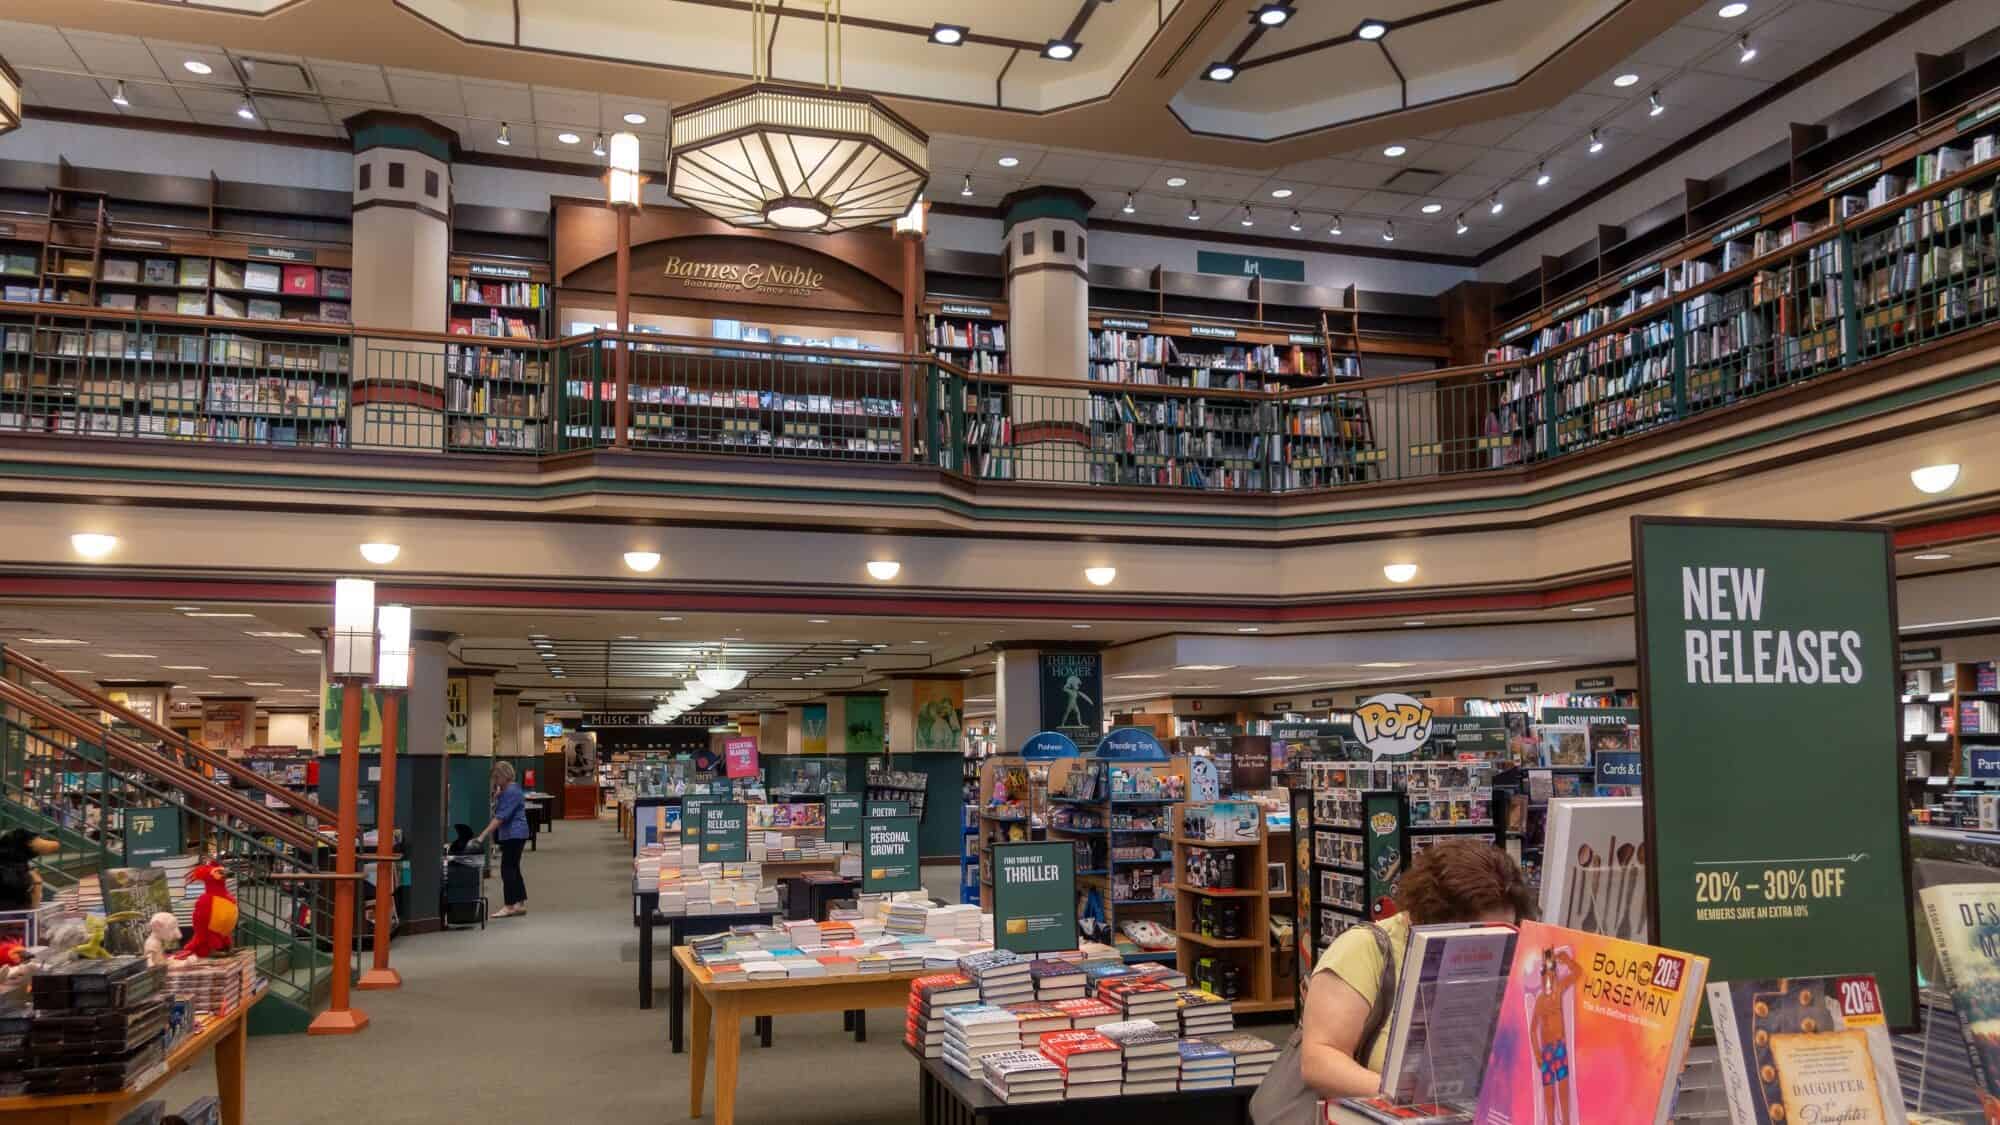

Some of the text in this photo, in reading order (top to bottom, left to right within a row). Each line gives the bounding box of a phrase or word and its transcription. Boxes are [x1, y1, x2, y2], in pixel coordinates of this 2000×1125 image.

[664, 256, 824, 289] Barnes & Noble
[1244, 258, 1260, 275] Art
[684, 279, 741, 290] Booksellers
[1682, 566, 1765, 621] NEW
[1068, 656, 1096, 665] ILIAD
[1685, 629, 1863, 684] RELEASES
[1051, 667, 1092, 677] HOMER
[591, 715, 631, 725] MUSIC
[682, 715, 720, 725] MUSIC
[1355, 702, 1434, 744] POP!
[1108, 741, 1153, 751] Trending Toys
[1603, 763, 1626, 775] Cards
[1628, 763, 1636, 775] &
[1977, 758, 2000, 770] Part
[707, 810, 723, 819] NEW
[872, 807, 897, 816] POETRY
[707, 819, 740, 829] RELEASES
[870, 832, 911, 844] PERSONAL
[871, 844, 904, 856] GROWTH
[1004, 865, 1059, 883] THRILLER
[1696, 872, 1741, 902] 20%
[1764, 869, 1807, 900] 30%
[1811, 868, 1846, 897] OFF
[1697, 904, 1808, 920] MEMBERS SAVE AN EXTRA 10%
[1959, 902, 2000, 928] DES
[1593, 952, 1652, 986] BOJAC
[1653, 956, 1680, 987] 20%
[1584, 978, 1670, 1016] HORSEMAN
[1841, 981, 1873, 1014] 20%
[1792, 1080, 1865, 1097] DAUGHTER
